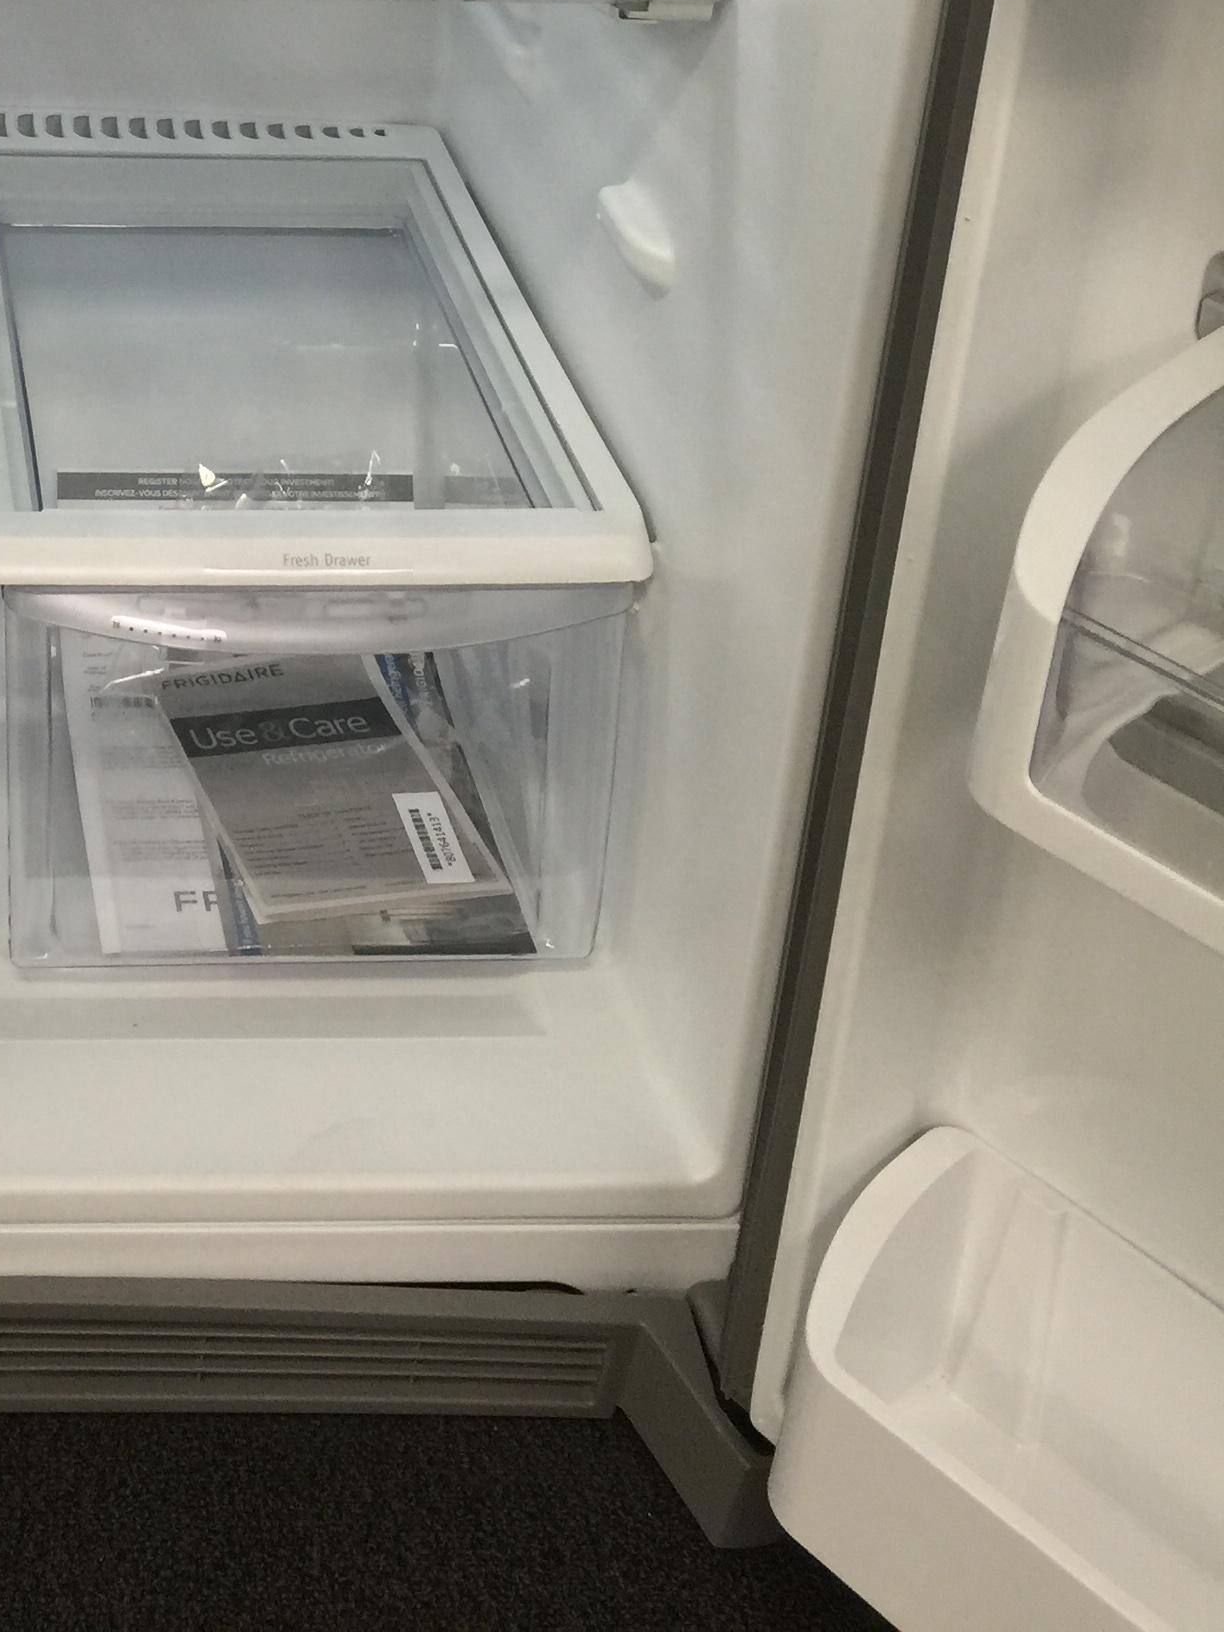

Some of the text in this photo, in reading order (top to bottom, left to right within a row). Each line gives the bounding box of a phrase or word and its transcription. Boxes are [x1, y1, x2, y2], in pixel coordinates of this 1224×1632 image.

[138, 476, 178, 486] REGISTER
[95, 488, 161, 497] INSCRIVEZ-VOUS
[283, 553, 371, 567] Fresh Drawer
[162, 663, 284, 690] FRIGIDAIRE
[189, 715, 371, 750] Use & Care
[262, 742, 388, 766] Refrigerator
